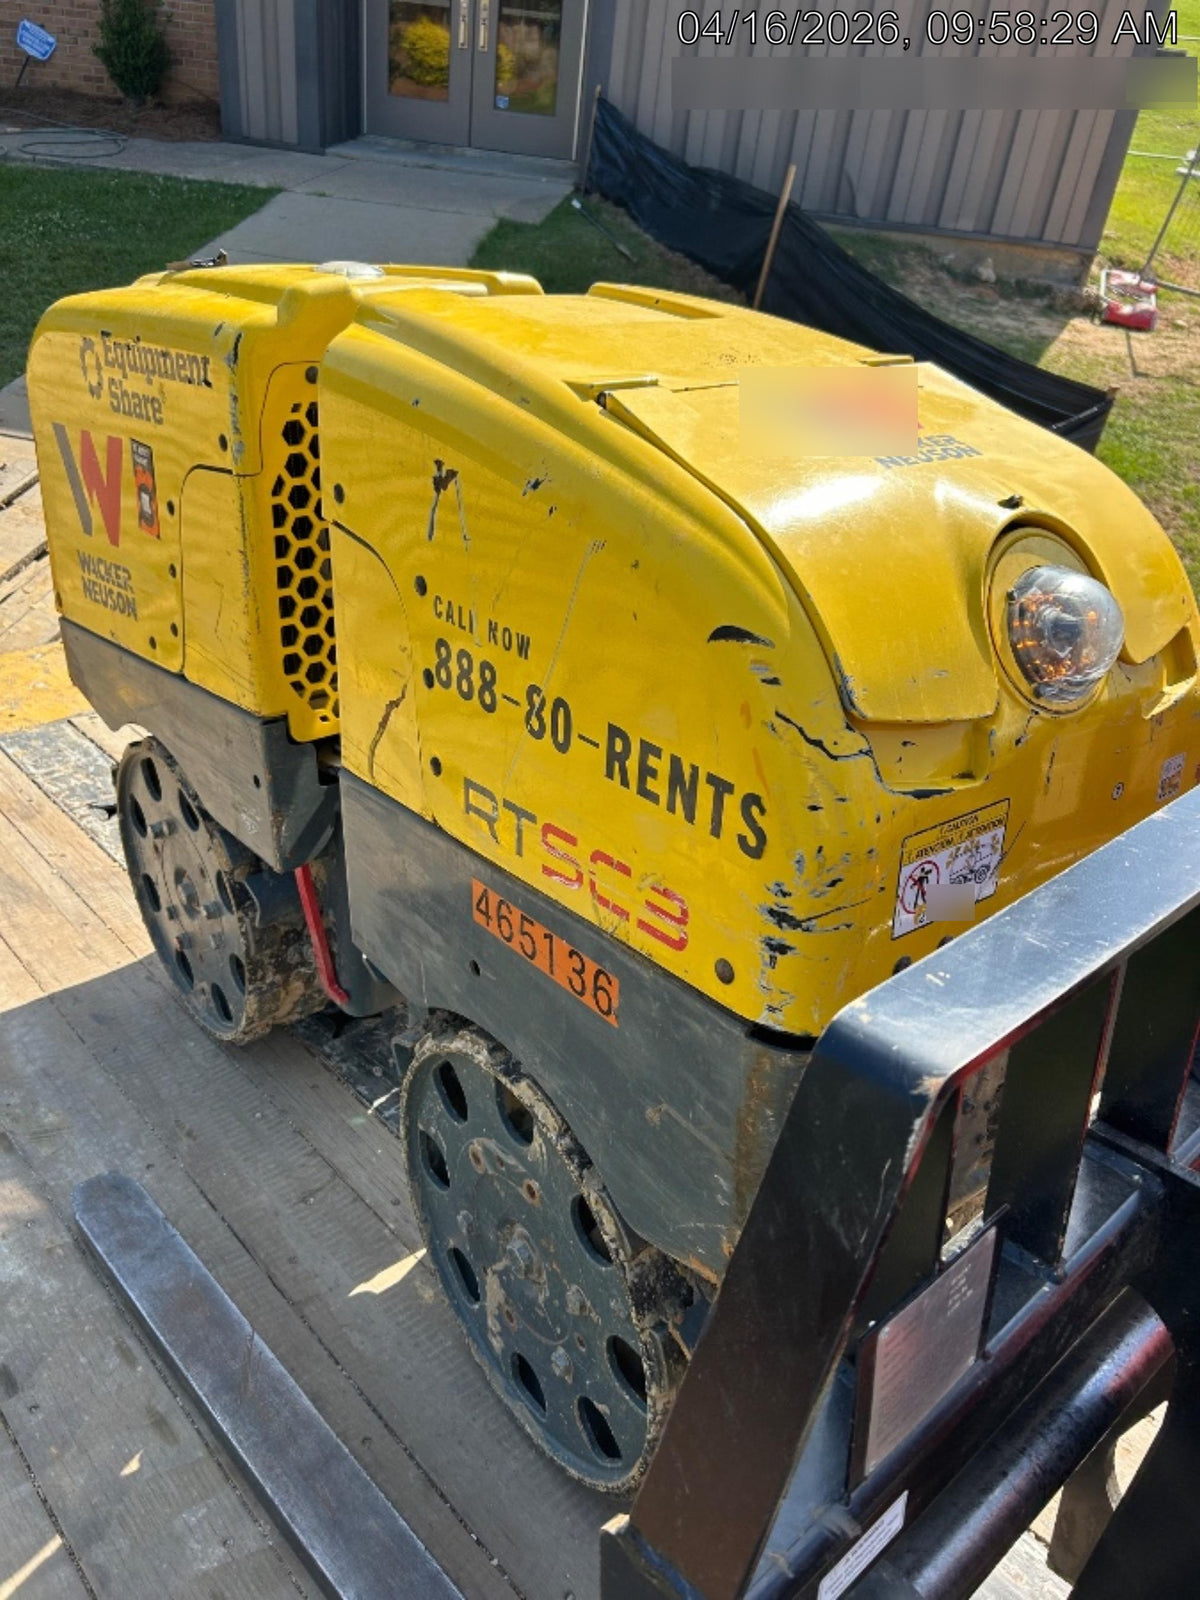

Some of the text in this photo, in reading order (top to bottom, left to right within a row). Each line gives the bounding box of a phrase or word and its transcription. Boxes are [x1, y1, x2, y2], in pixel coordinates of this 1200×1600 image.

[101, 331, 212, 388] Equipment
[108, 376, 164, 425] Share
[77, 549, 134, 594] WACKER
[82, 575, 138, 622] NEUSON
[488, 618, 530, 660] NOW
[434, 638, 767, 860] 888-80-RENTS
[475, 887, 614, 1018] 465136
